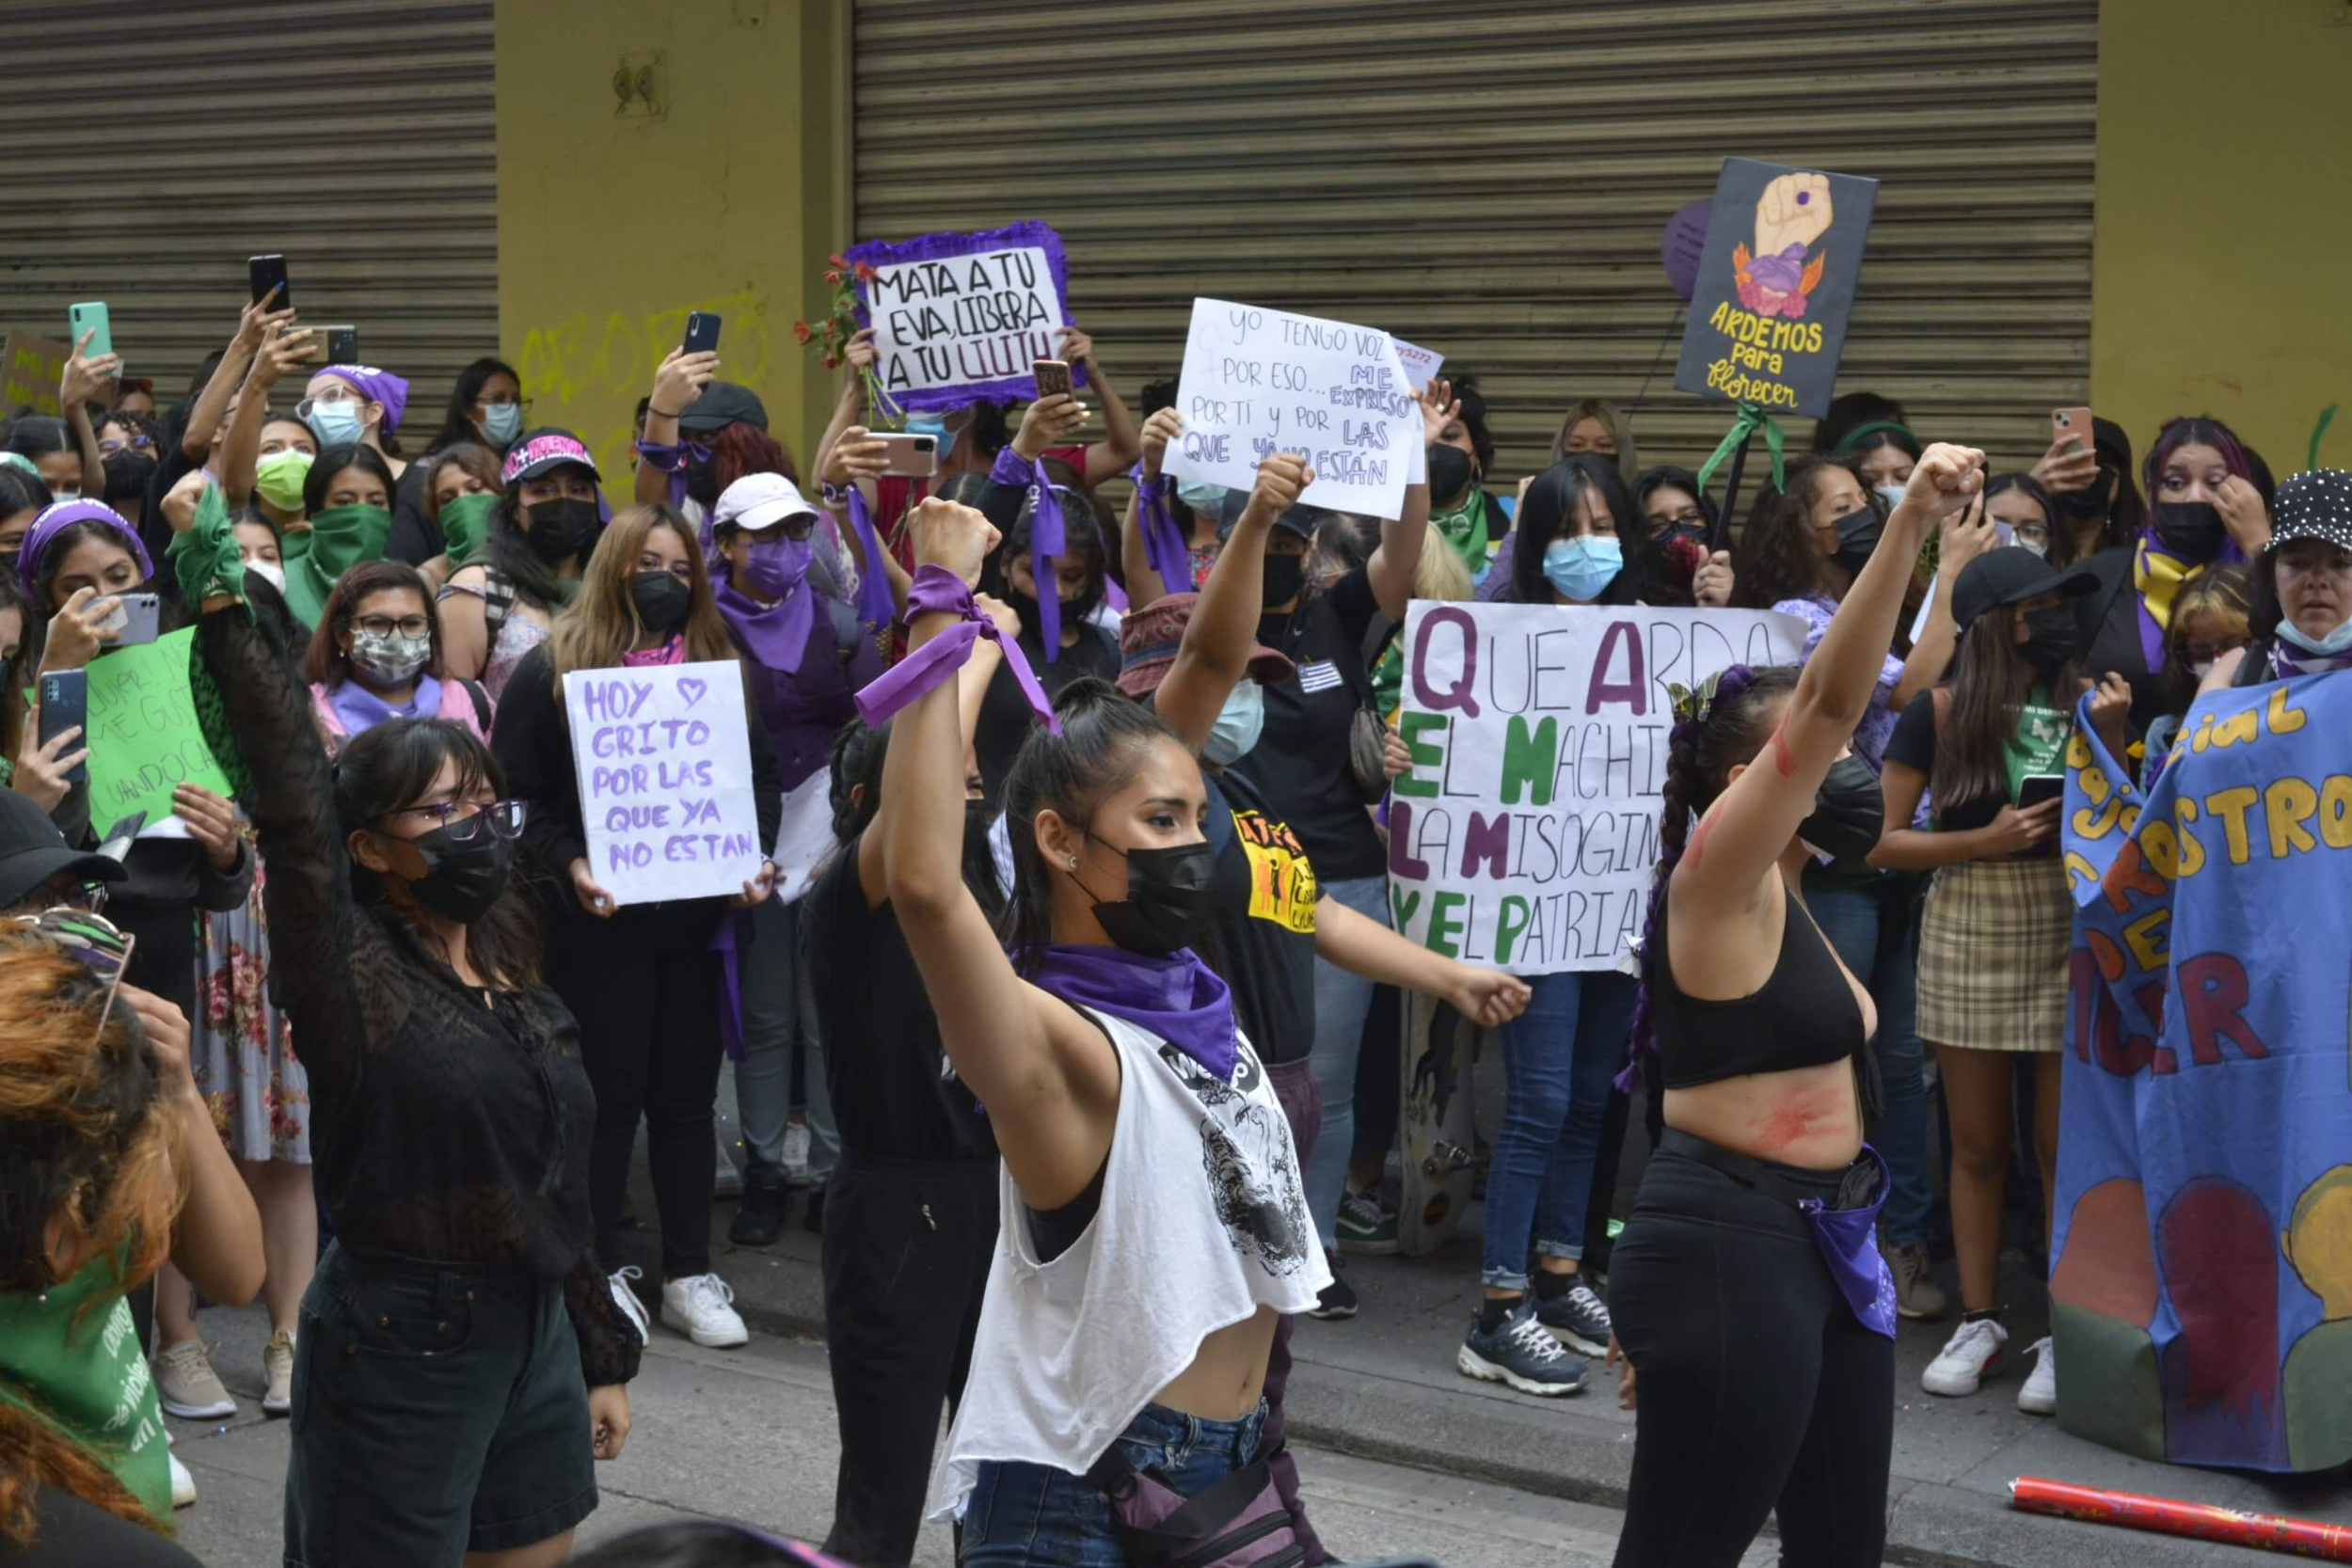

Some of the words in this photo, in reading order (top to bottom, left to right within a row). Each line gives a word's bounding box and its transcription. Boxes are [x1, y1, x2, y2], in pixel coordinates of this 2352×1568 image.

[871, 262, 961, 307] MATA
[969, 259, 993, 293] A
[990, 250, 1036, 289] TU
[953, 290, 1050, 337] LIBERA
[1279, 318, 1347, 352] TENGO
[1354, 331, 1386, 361] VOZ
[1708, 300, 1823, 353] ARDEMOS
[887, 352, 912, 390] A
[913, 344, 952, 384] TU
[957, 330, 1053, 380] LILITH
[1223, 356, 1263, 388] POR
[1350, 364, 1393, 390] ME
[1707, 357, 1799, 408] florecer
[1192, 395, 1227, 426] POR
[1295, 405, 1330, 432] POR
[1343, 420, 1390, 451] LAS
[1328, 384, 1410, 419] EXPRESO
[1183, 431, 1231, 464] QUE
[1316, 450, 1388, 486] ESTÁN
[1411, 605, 1572, 720] QUE
[583, 679, 654, 723] HOY
[591, 717, 710, 759] GRITO
[1392, 710, 1480, 800] EL
[1499, 713, 1665, 807] MACHI
[592, 763, 649, 799] POR
[658, 759, 713, 790] LAS
[605, 803, 671, 833] QUE
[678, 798, 722, 829] YA
[609, 840, 653, 875] NO
[663, 831, 754, 863] ESTAN
[1388, 800, 1453, 881] LA
[1459, 810, 1663, 884] MISOGIN
[1392, 882, 1421, 937] Y
[1424, 890, 1486, 961] EL
[1493, 887, 1641, 965] PATRIA
[120, 1351, 151, 1411] violen
